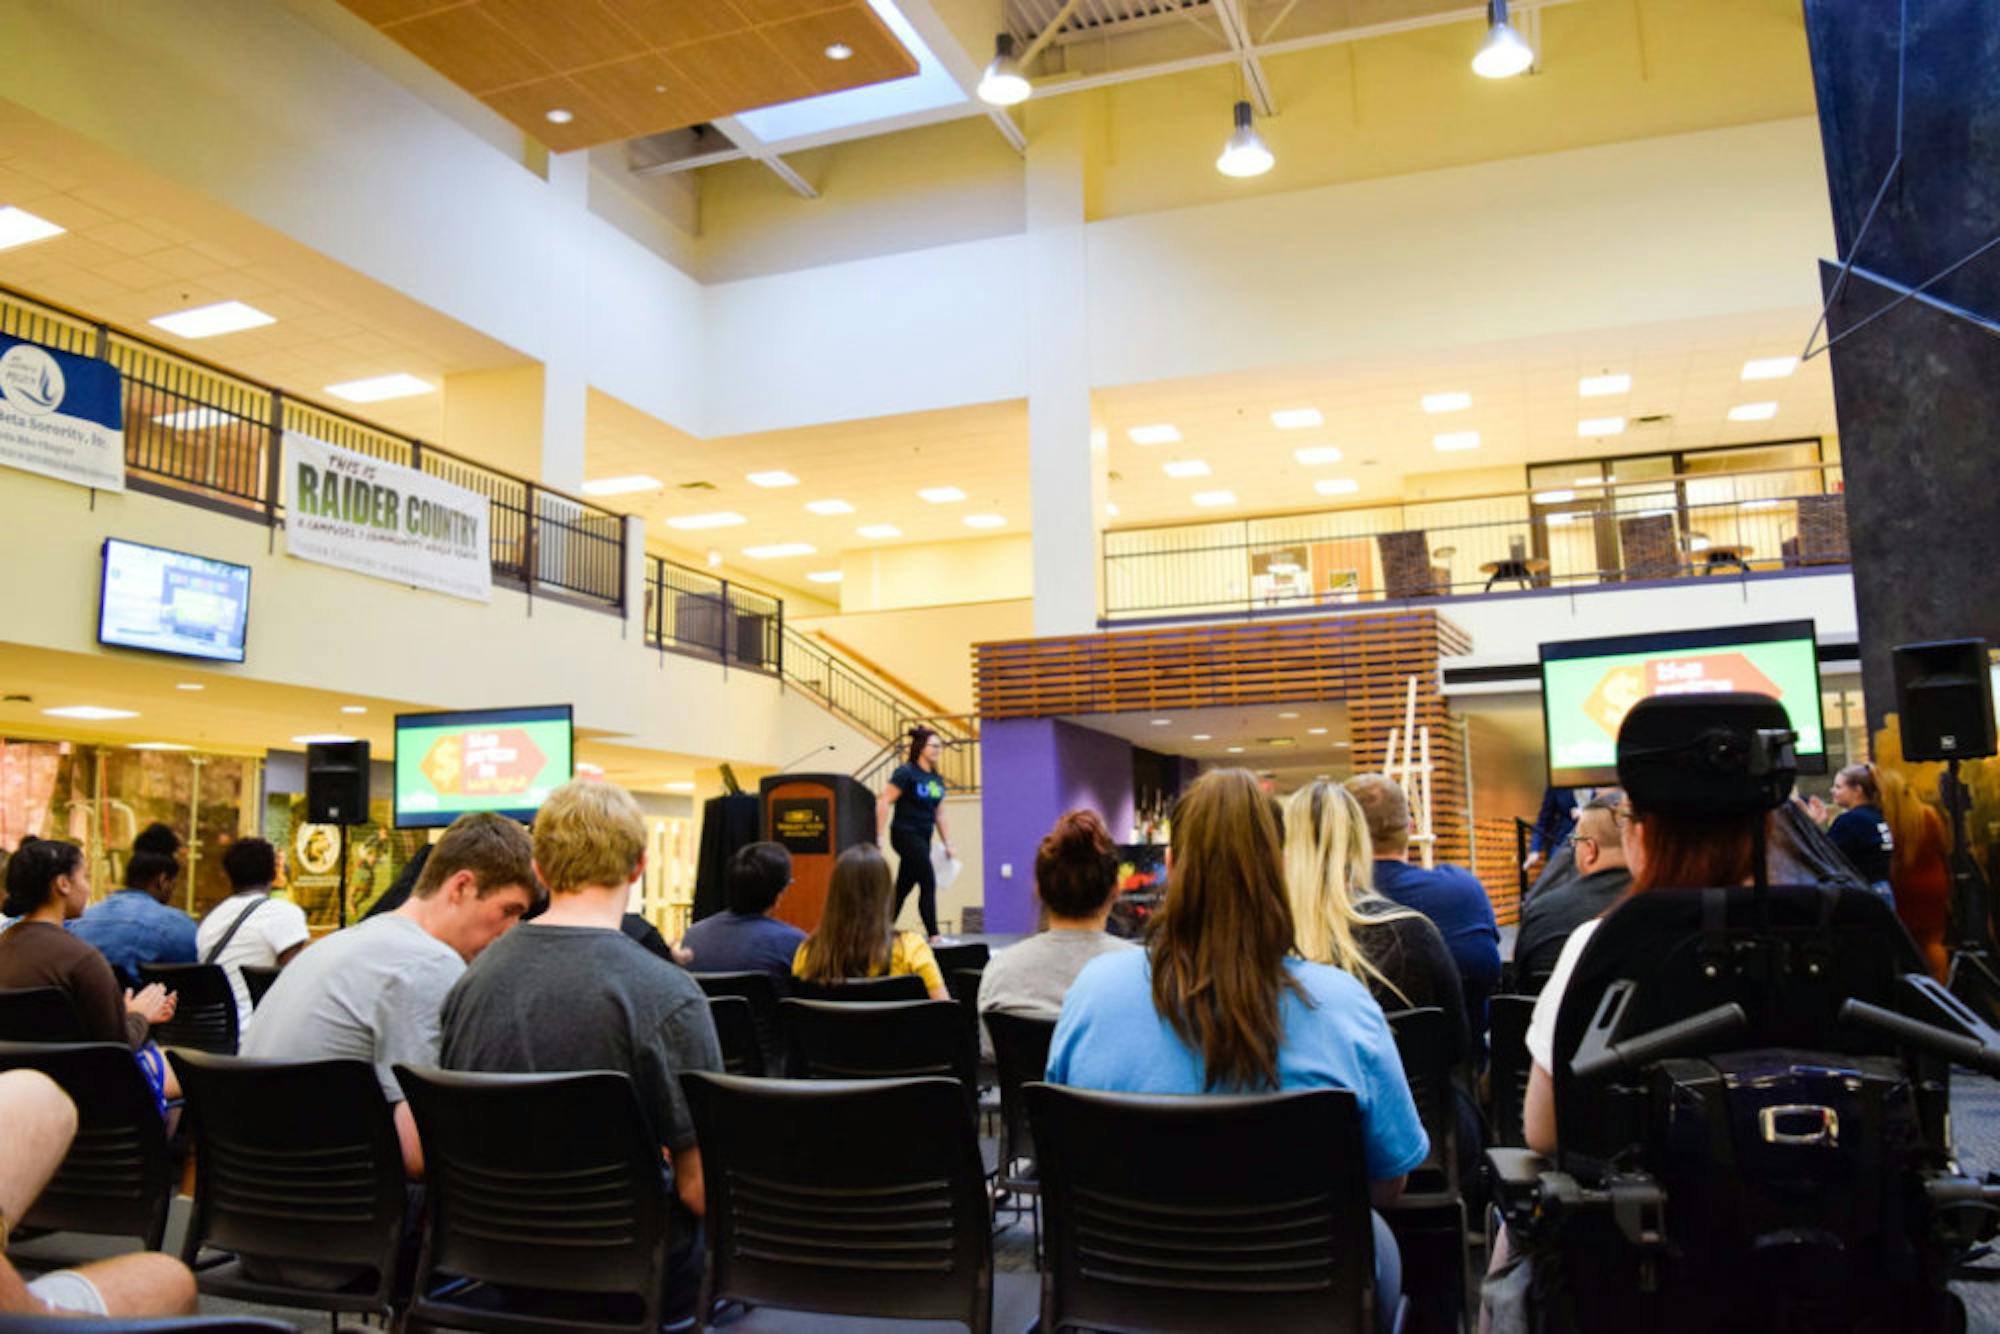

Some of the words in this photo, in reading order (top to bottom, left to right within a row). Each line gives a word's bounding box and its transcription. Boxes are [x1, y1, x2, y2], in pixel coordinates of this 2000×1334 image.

[329, 454, 360, 475] THIS
[297, 461, 399, 530] RAIDER
[406, 494, 478, 550] COUNTRY
